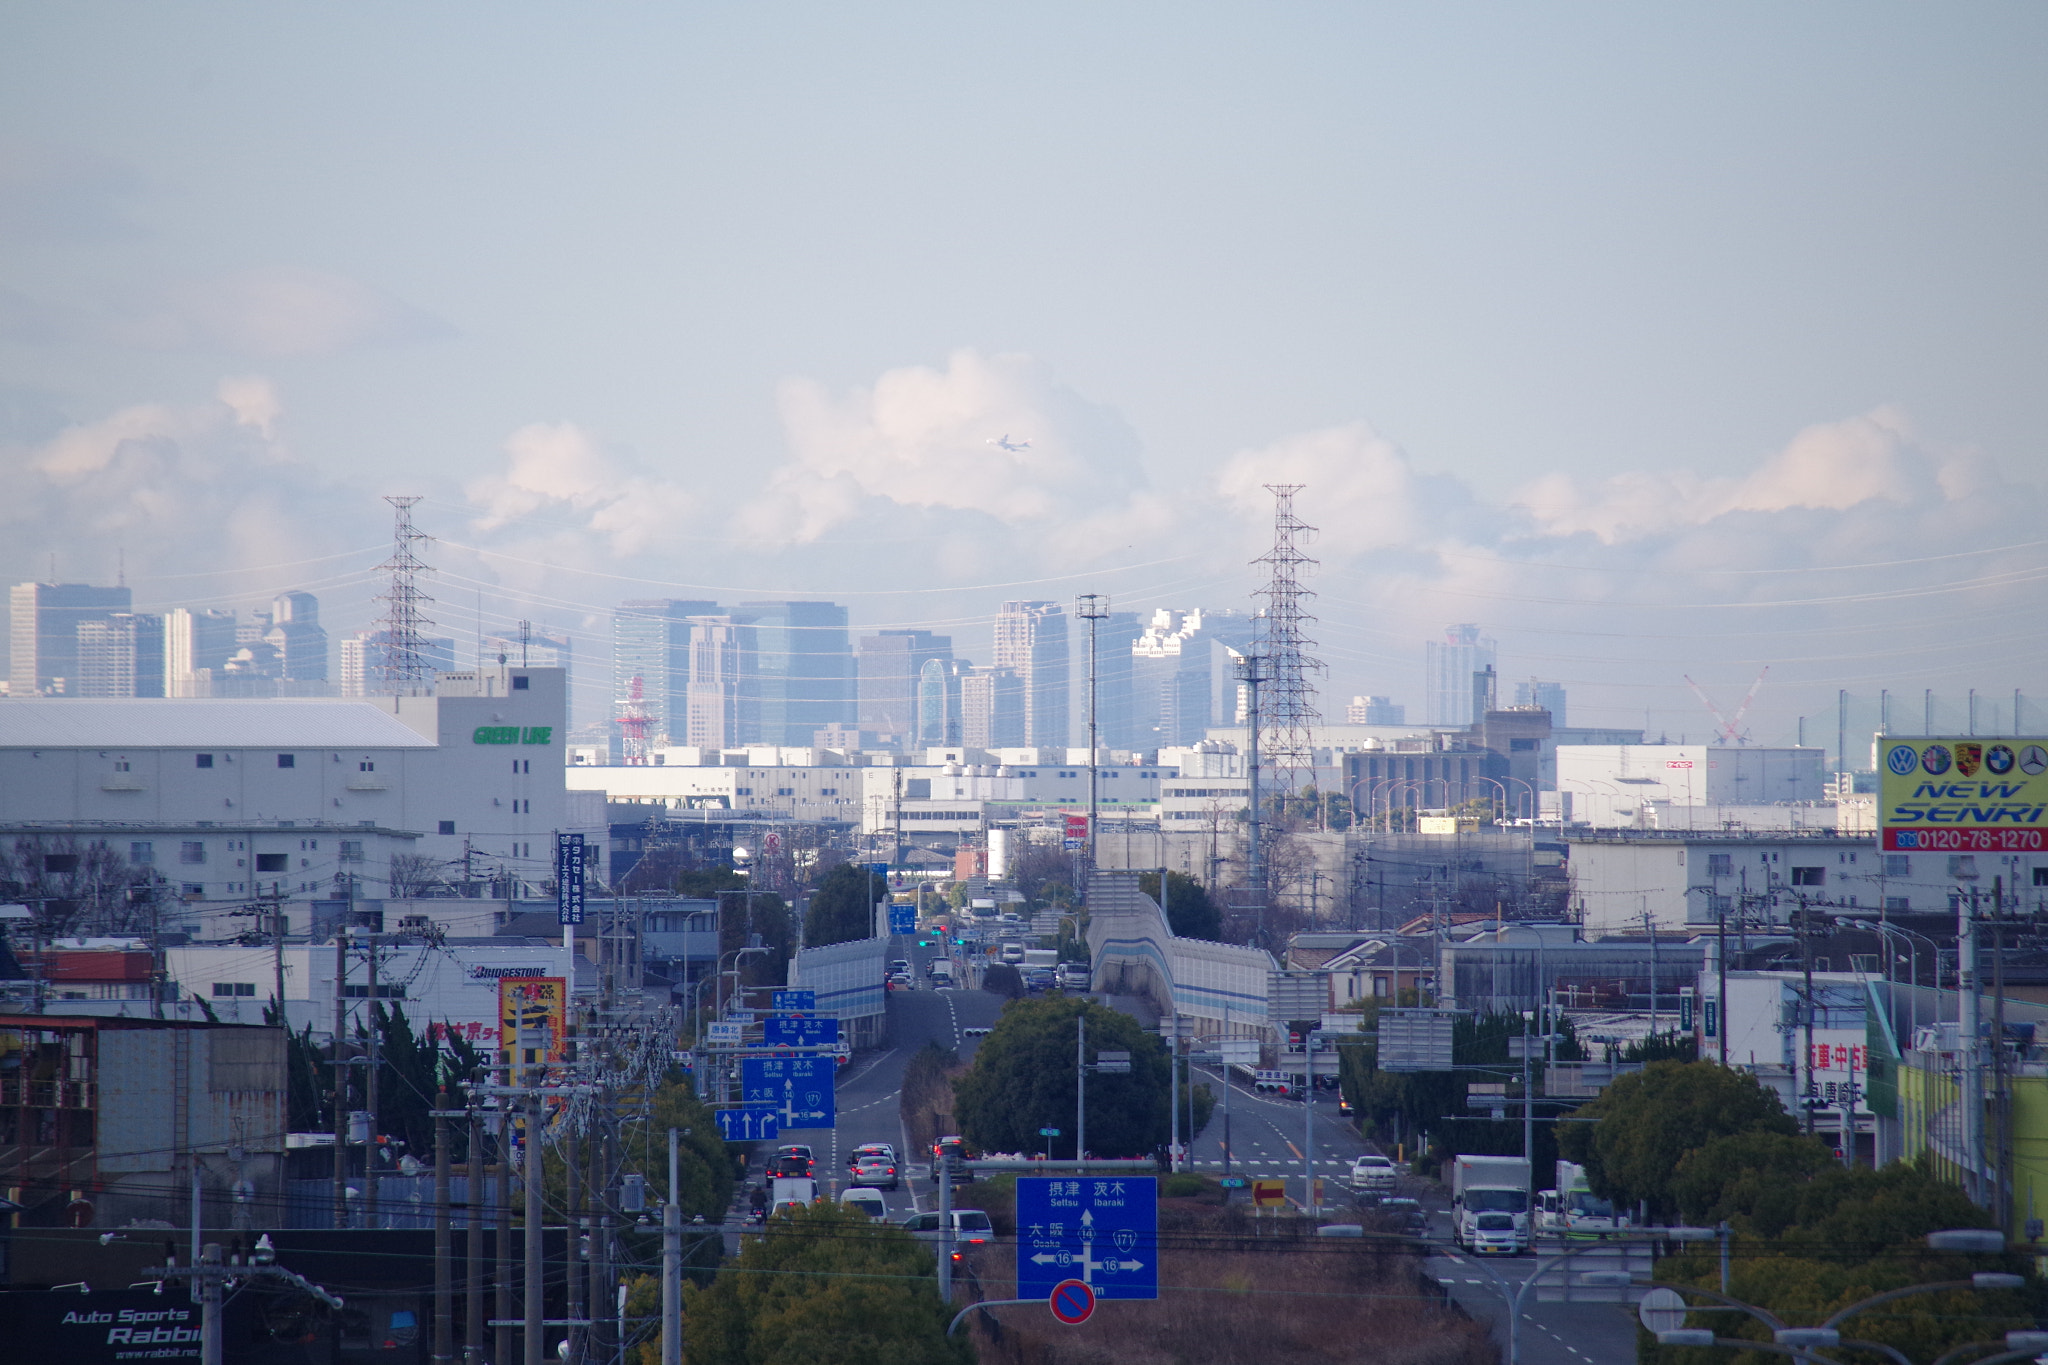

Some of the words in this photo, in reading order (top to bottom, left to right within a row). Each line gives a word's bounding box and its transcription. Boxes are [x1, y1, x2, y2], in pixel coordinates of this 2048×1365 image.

[473, 727, 520, 744] GREEN
[522, 727, 552, 744] LINE
[1912, 781, 2028, 798] NEW
[1889, 803, 2048, 822] SENRI
[1918, 830, 2042, 849] 0120-78-1270
[474, 966, 546, 978] BRIDGESTONE
[711, 1025, 738, 1034] 唐崎北
[779, 1021, 798, 1029] 摂津
[804, 1020, 823, 1029] 茨木
[763, 1061, 783, 1071] 摂津
[792, 1060, 813, 1071] 茨木
[751, 1088, 773, 1098] 大阪
[784, 1090, 794, 1099] 14
[807, 1094, 819, 1103] 171
[800, 1111, 809, 1120] 16
[1049, 1181, 1080, 1197] 摂津
[1093, 1181, 1125, 1197] 茨木
[1050, 1198, 1079, 1207] Settsu
[1094, 1198, 1124, 1207] Ibaraki
[1029, 1222, 1063, 1238] 大阪
[1080, 1228, 1093, 1238] 14
[1032, 1238, 1060, 1248] Osaka
[1117, 1233, 1132, 1245] 171
[1058, 1253, 1071, 1265] 16
[1104, 1260, 1118, 1271] 16
[62, 1311, 113, 1324] Auto
[117, 1308, 190, 1325] Sports
[107, 1326, 203, 1344] Rabbi
